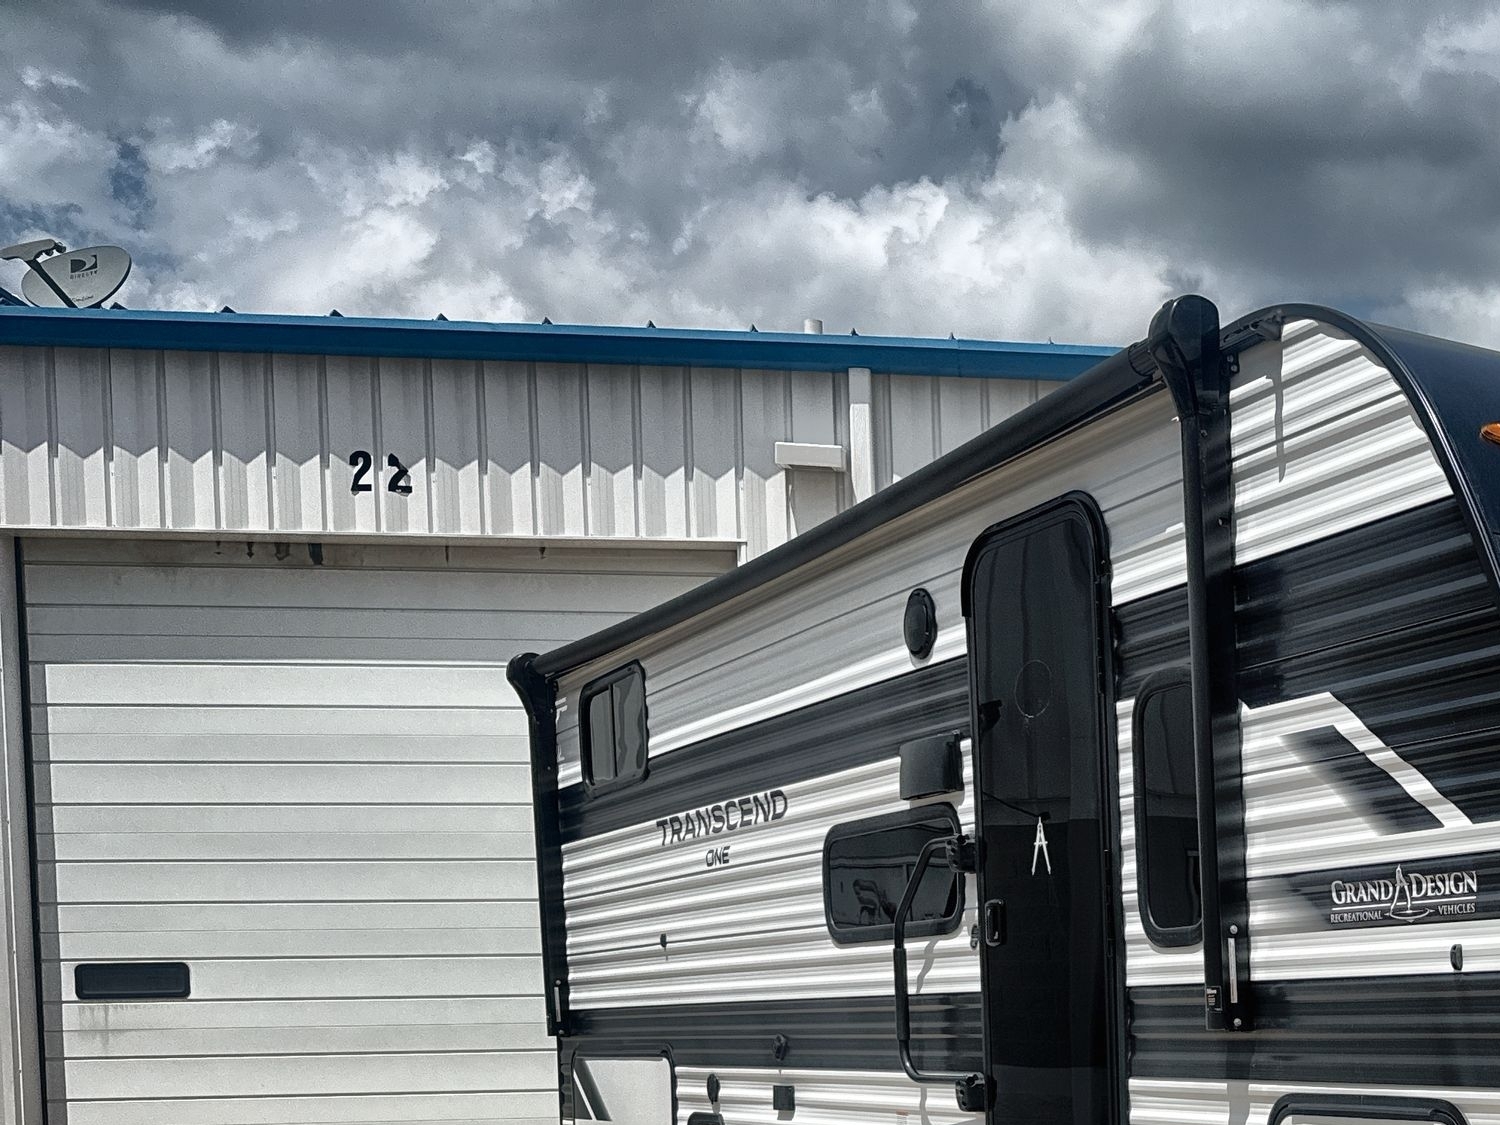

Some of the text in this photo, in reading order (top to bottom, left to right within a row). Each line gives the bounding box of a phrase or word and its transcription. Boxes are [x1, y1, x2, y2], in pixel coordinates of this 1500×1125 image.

[349, 450, 413, 493] 22
[656, 789, 788, 846] TRANSCEND
[706, 846, 731, 867] ONE
[1331, 871, 1477, 904] GRAND DESIGN
[1330, 903, 1476, 923] RECREATIONAL VEHICLES
